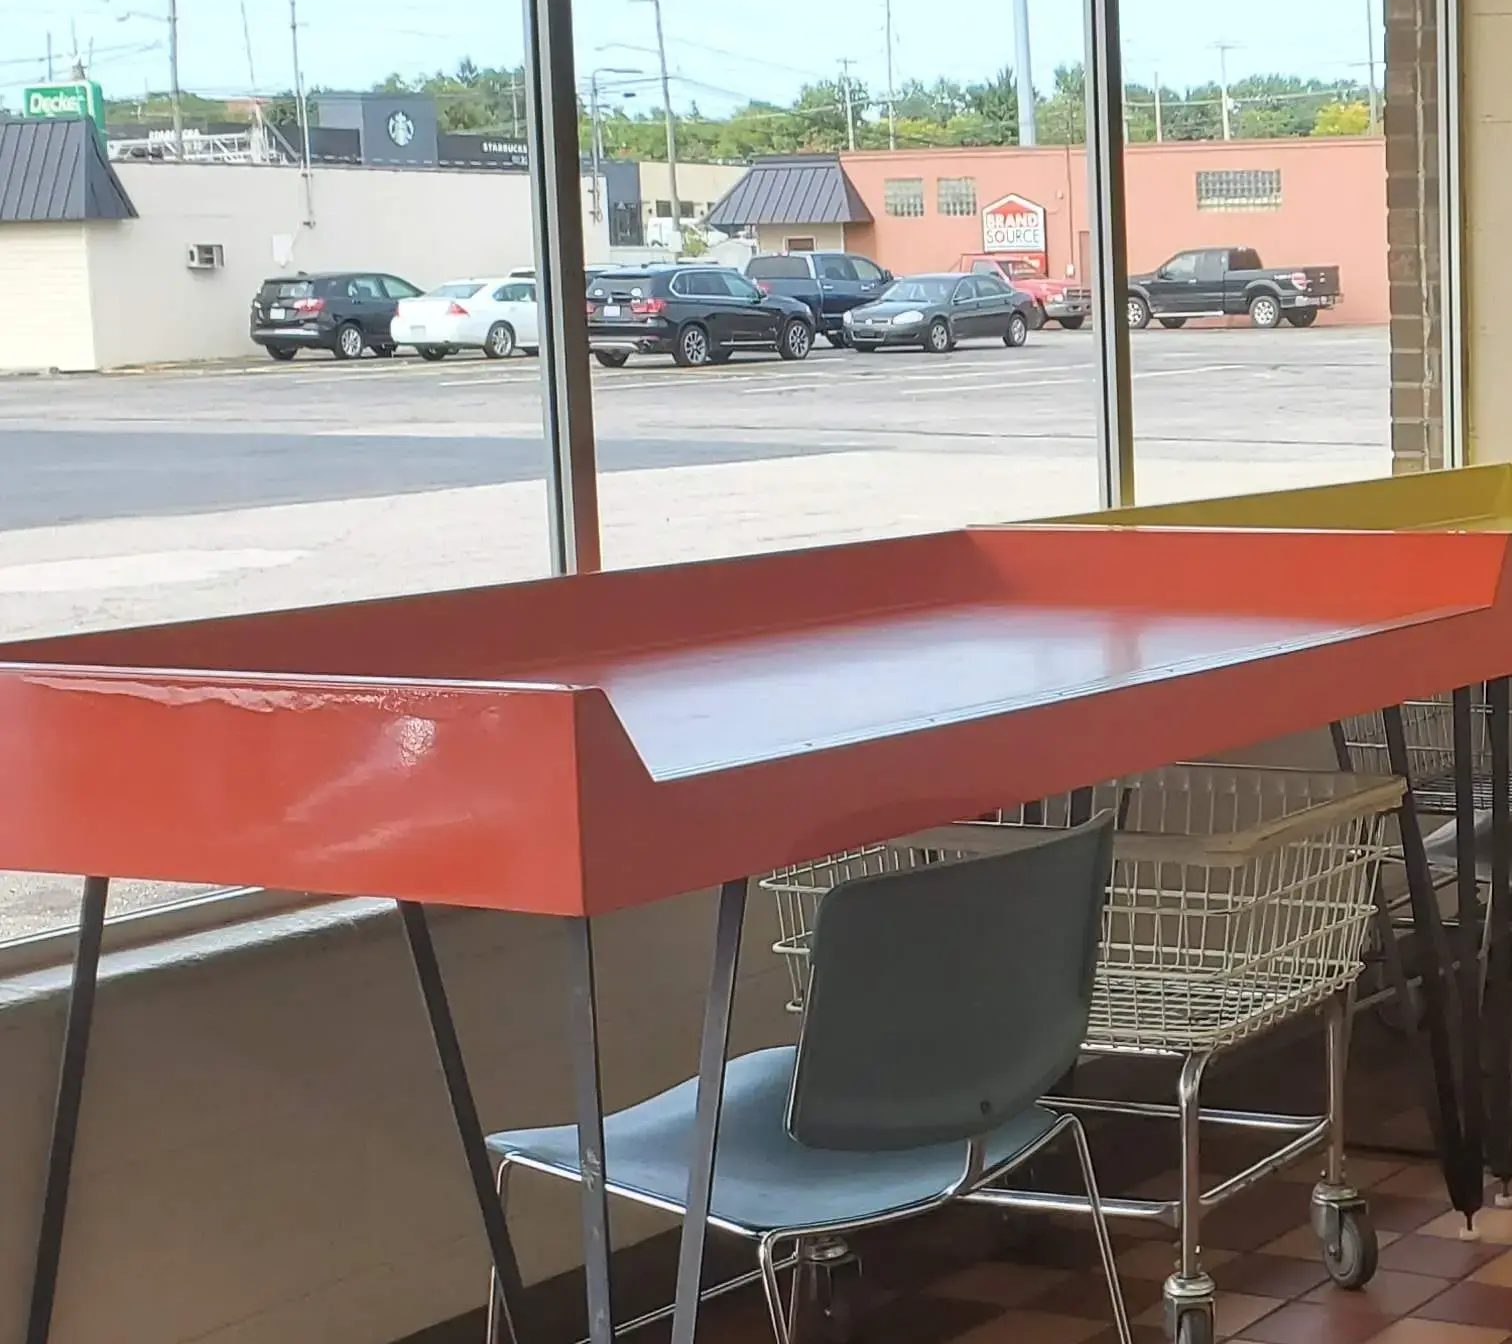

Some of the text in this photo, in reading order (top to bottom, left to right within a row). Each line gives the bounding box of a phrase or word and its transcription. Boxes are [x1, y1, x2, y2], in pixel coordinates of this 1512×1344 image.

[483, 141, 528, 154] STARBUCKS
[986, 212, 1039, 229] BRAND
[986, 229, 1039, 244] SOURCE
